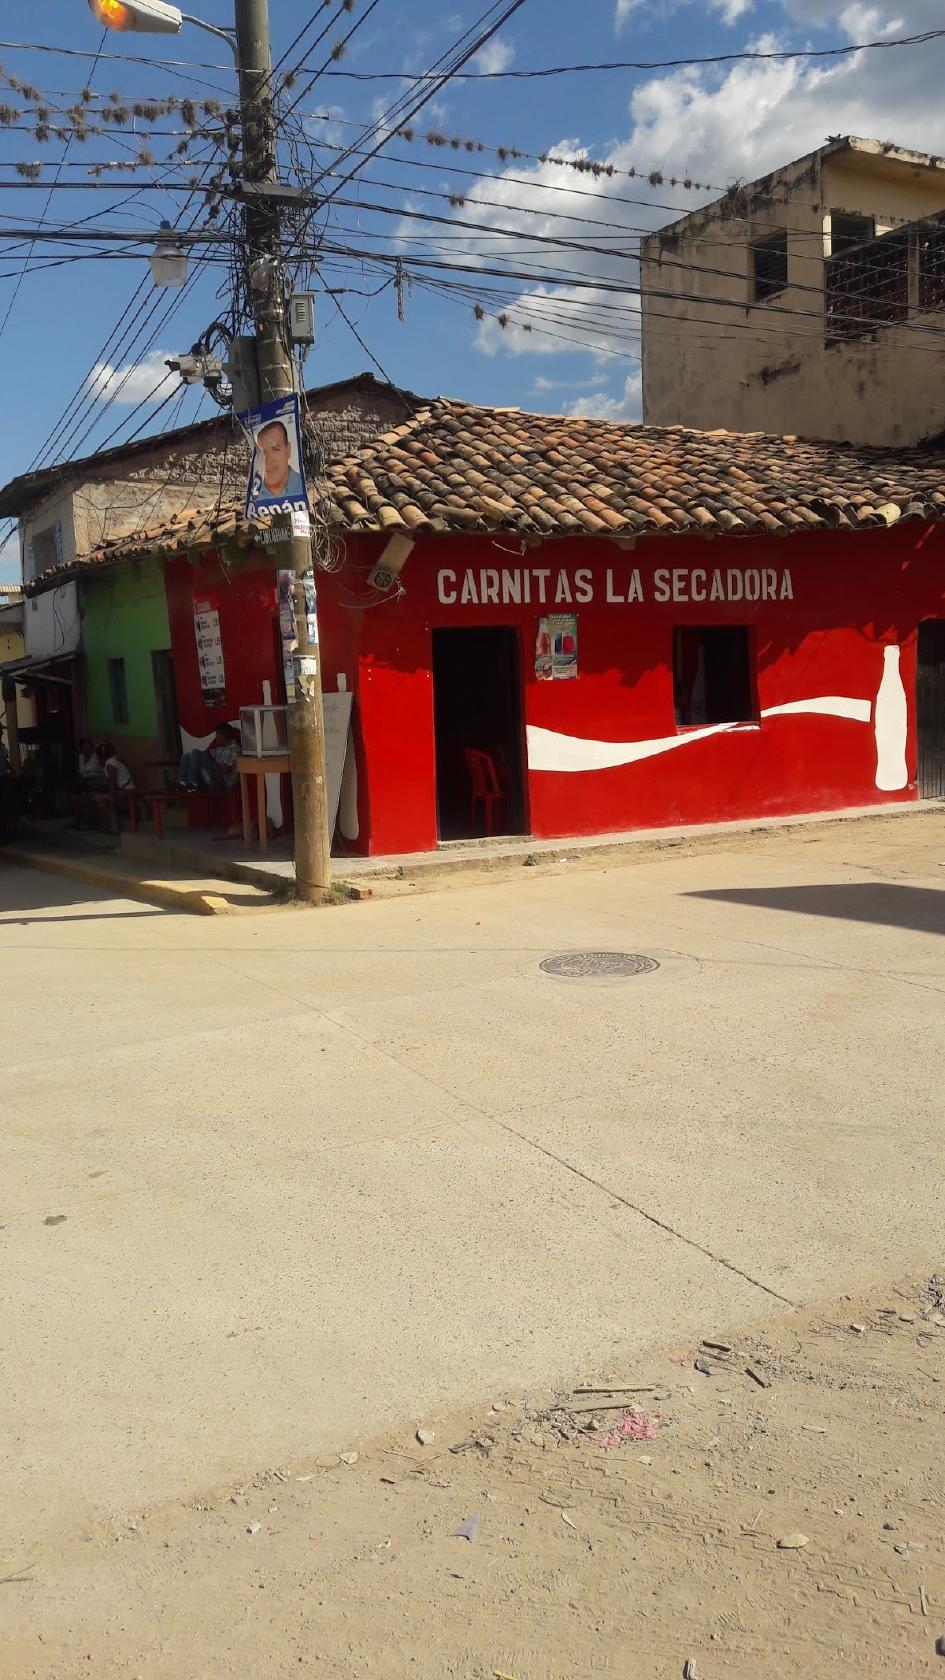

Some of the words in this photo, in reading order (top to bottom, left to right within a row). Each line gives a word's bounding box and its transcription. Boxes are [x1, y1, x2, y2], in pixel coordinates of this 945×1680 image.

[247, 500, 307, 519] Renán
[437, 568, 594, 604] CARNITAS
[606, 568, 644, 603] LA
[654, 568, 794, 602] SECADORA
